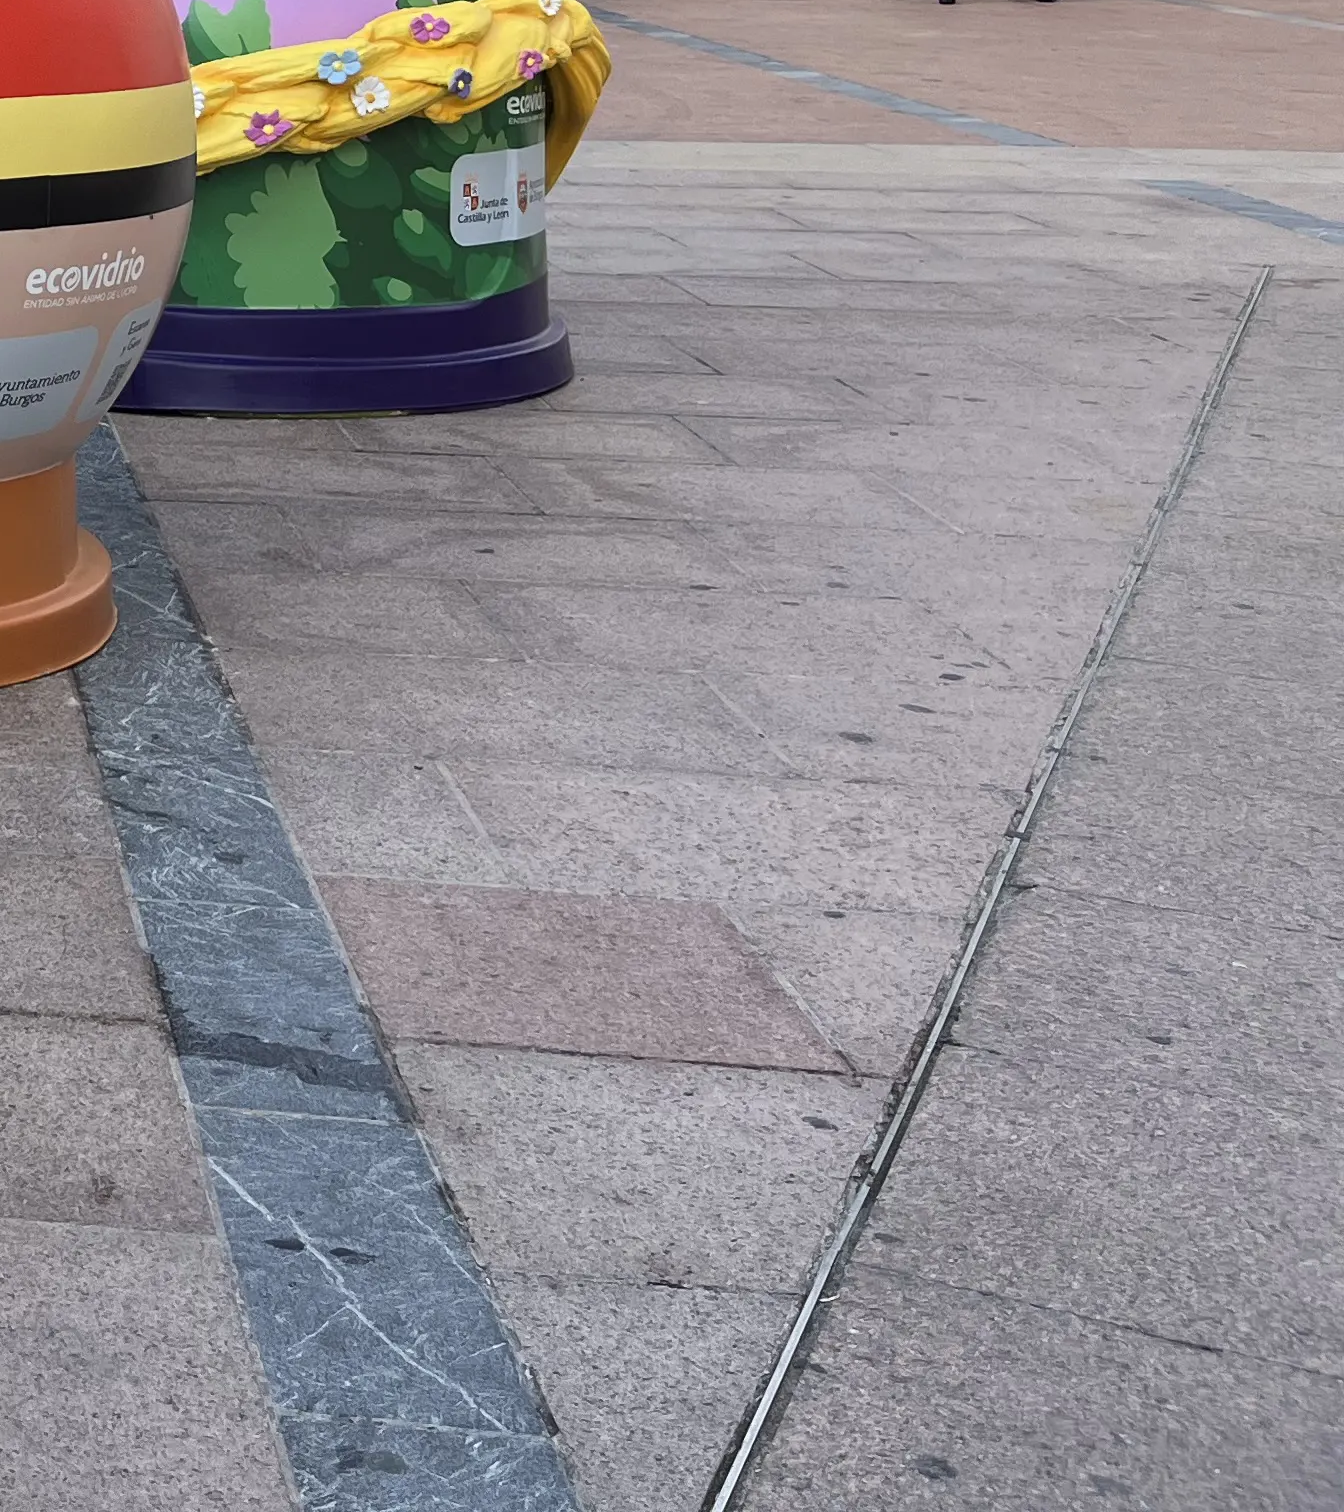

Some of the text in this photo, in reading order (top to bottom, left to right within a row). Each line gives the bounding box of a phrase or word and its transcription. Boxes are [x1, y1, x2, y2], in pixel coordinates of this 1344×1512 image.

[457, 213, 487, 224] Castilla
[25, 246, 145, 295] ecovidrio
[23, 297, 65, 309] ENTIDAD
[65, 296, 80, 307] SIN
